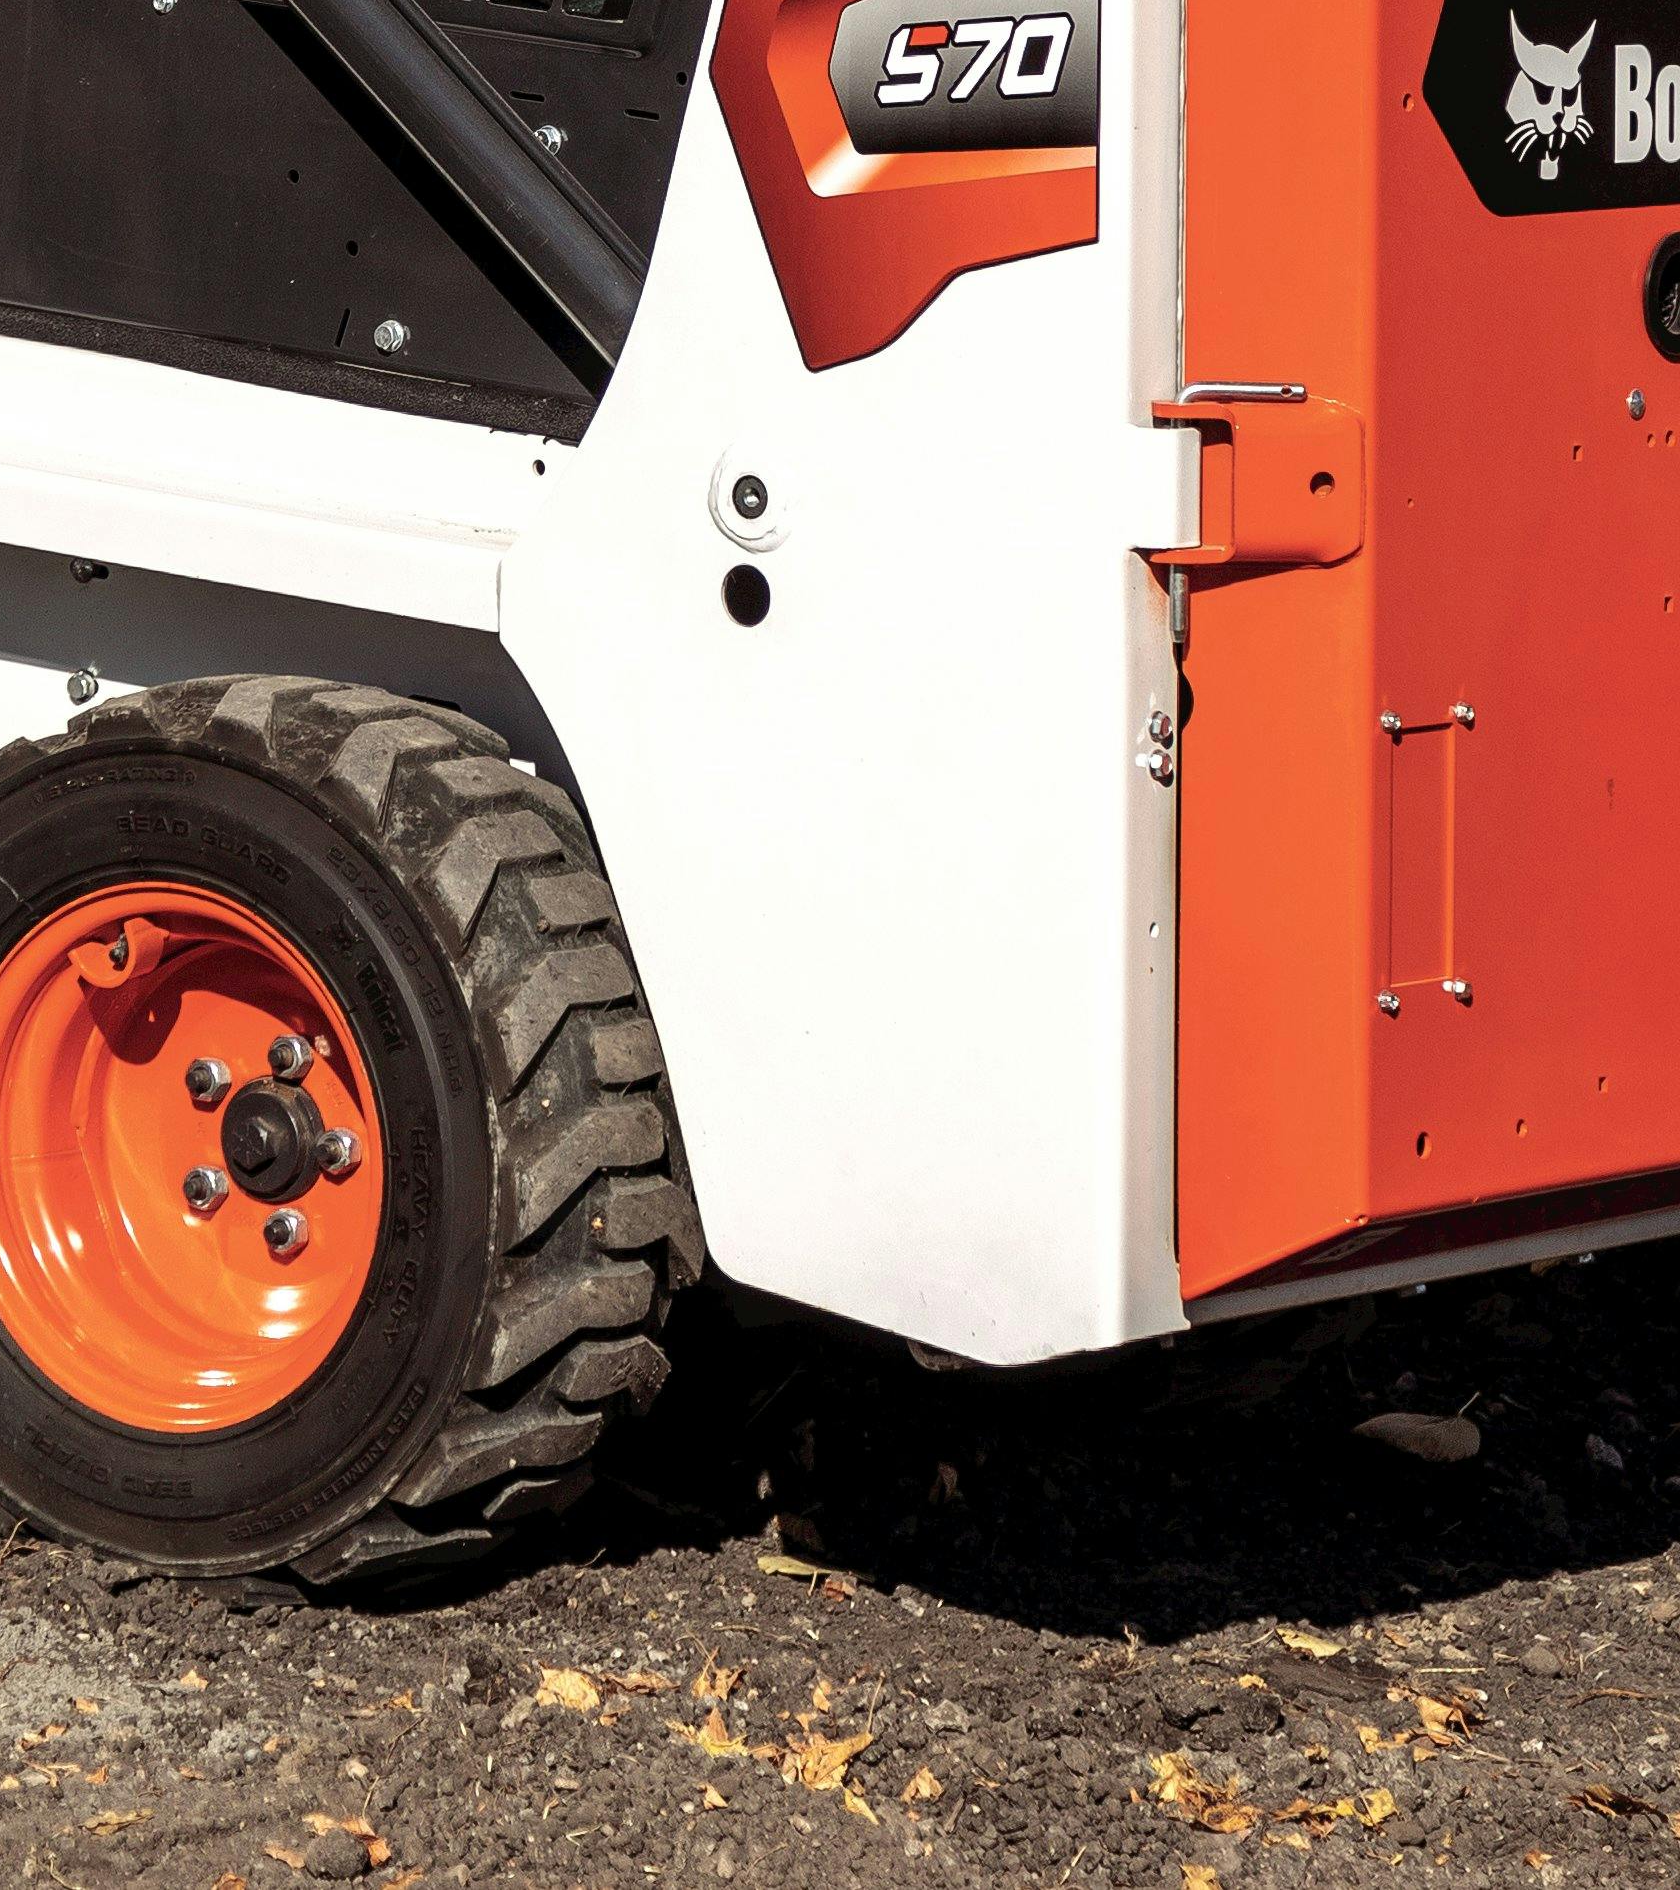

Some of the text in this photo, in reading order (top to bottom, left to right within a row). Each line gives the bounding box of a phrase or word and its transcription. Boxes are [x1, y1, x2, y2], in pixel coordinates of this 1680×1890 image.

[875, 12, 1075, 108] S70
[114, 814, 295, 890] BEAD GUARD
[322, 840, 446, 1022] 23X8.50-12
[408, 1124, 431, 1241] HEAVY
